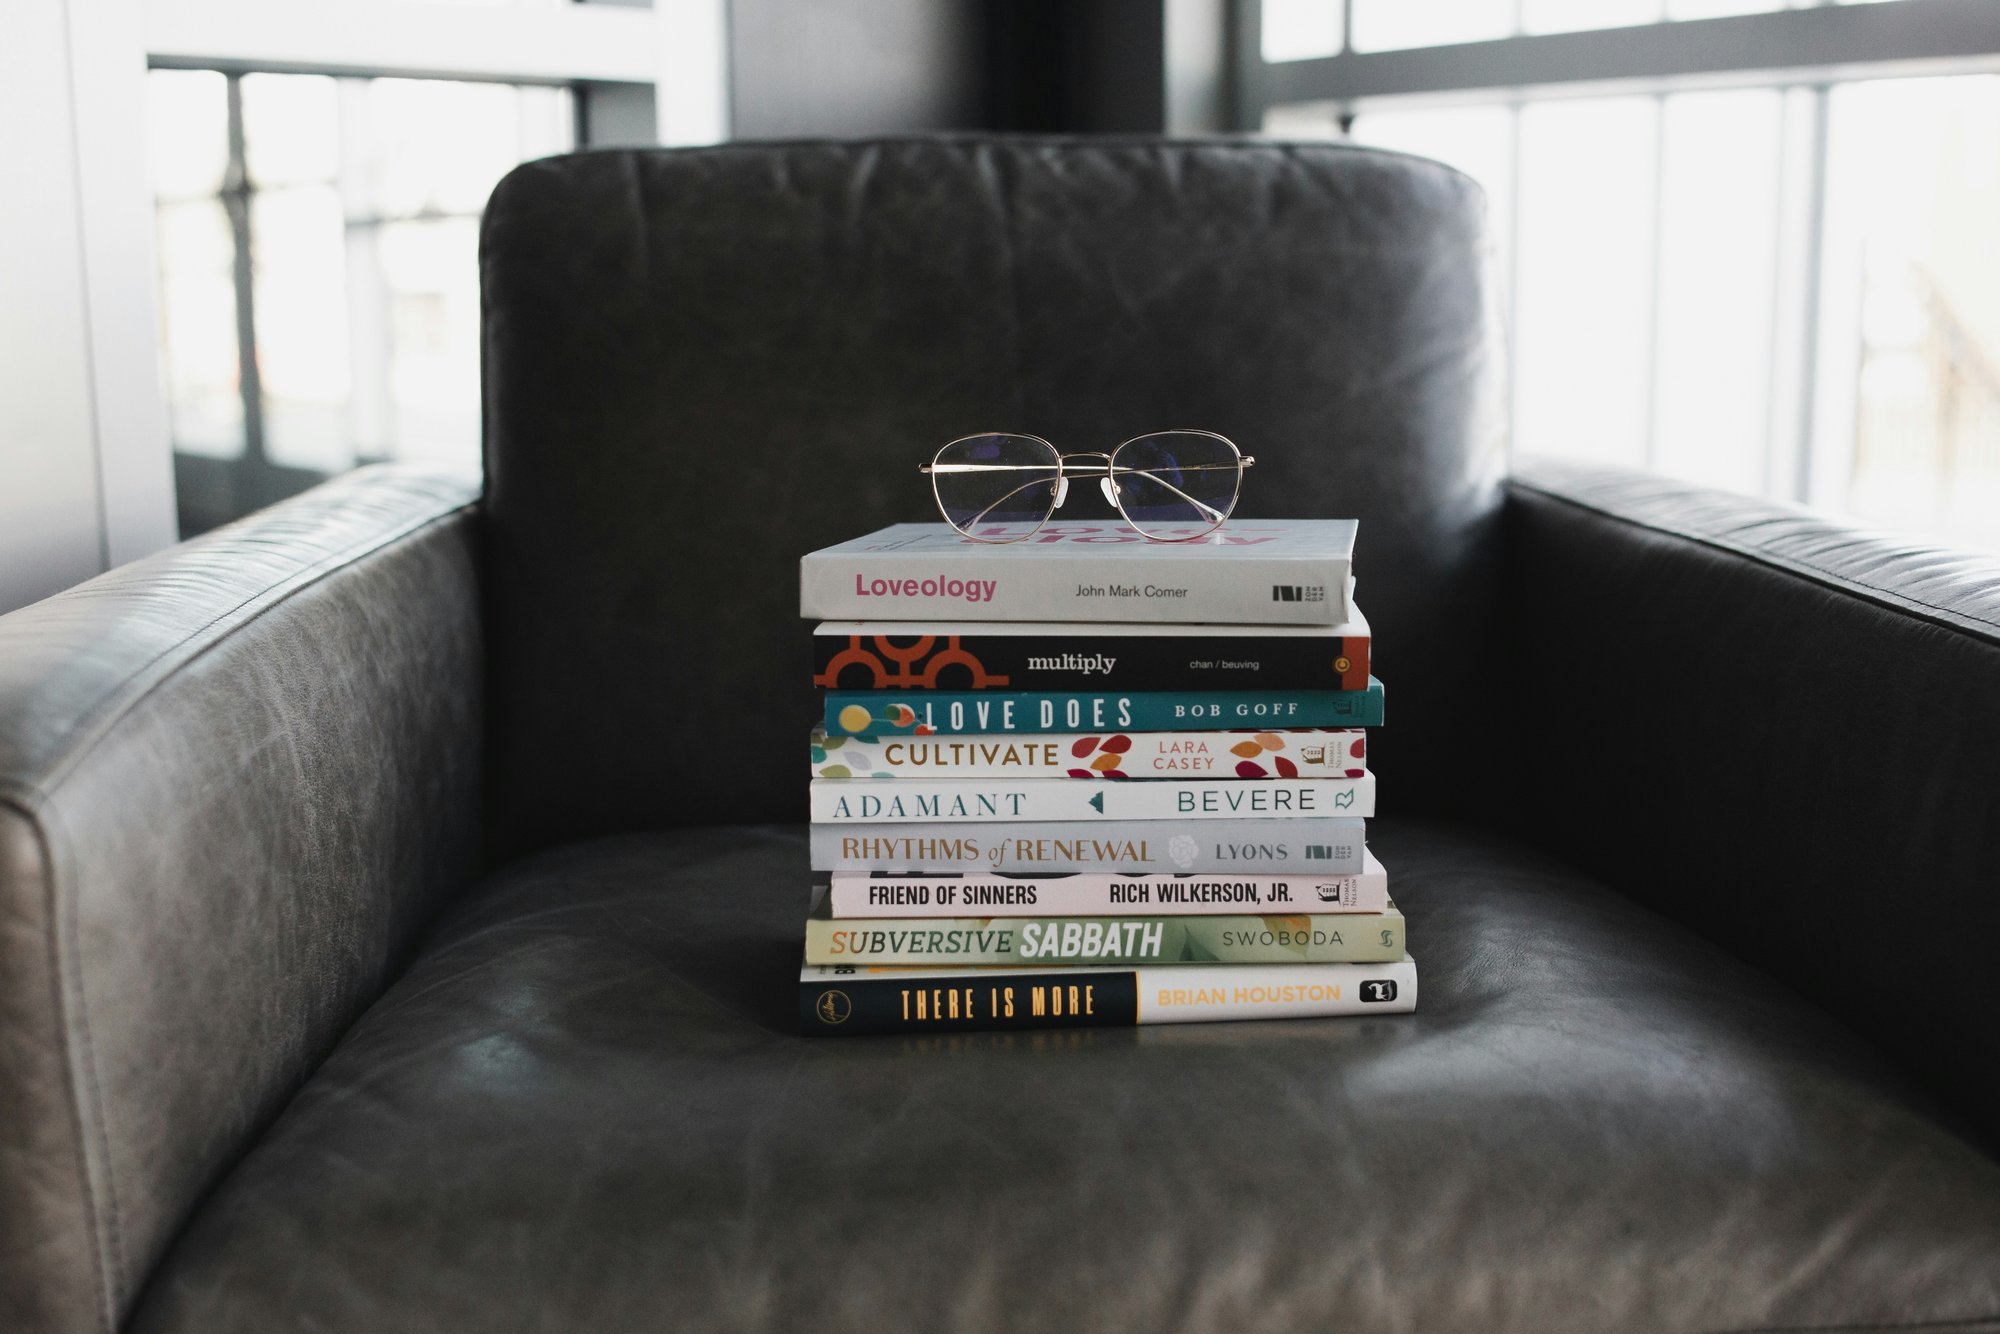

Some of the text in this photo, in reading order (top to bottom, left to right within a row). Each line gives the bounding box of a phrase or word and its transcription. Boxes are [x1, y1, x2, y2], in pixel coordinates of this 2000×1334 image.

[857, 574, 996, 602] Loveology
[1076, 585, 1187, 597] John Mark Comer
[1028, 654, 1115, 674] multiply
[1189, 660, 1214, 669] chan
[1222, 661, 1259, 670] beuving
[926, 698, 1130, 731] LOVE DOES
[1176, 703, 1297, 717] BOB GOFF
[886, 744, 1058, 765] CULTIVATE
[1160, 741, 1208, 753] LARA
[1154, 758, 1213, 769] CASEY
[833, 793, 1026, 818] ADAMANT
[1179, 789, 1314, 811] BEVERE
[843, 838, 1156, 868] RHYTHMS of RENEWAL
[1217, 845, 1287, 860] LYONS
[870, 886, 1036, 904] FRIEND OF SINNERS
[1110, 883, 1292, 904] RICH WILKERSON, JR.
[829, 922, 1164, 958] SUBVERSIVE SABBATH
[1223, 929, 1344, 947] SWOBODA
[902, 986, 1093, 1019] THERE IS MORE
[1157, 985, 1341, 1006] BRIAN HOUSTON
